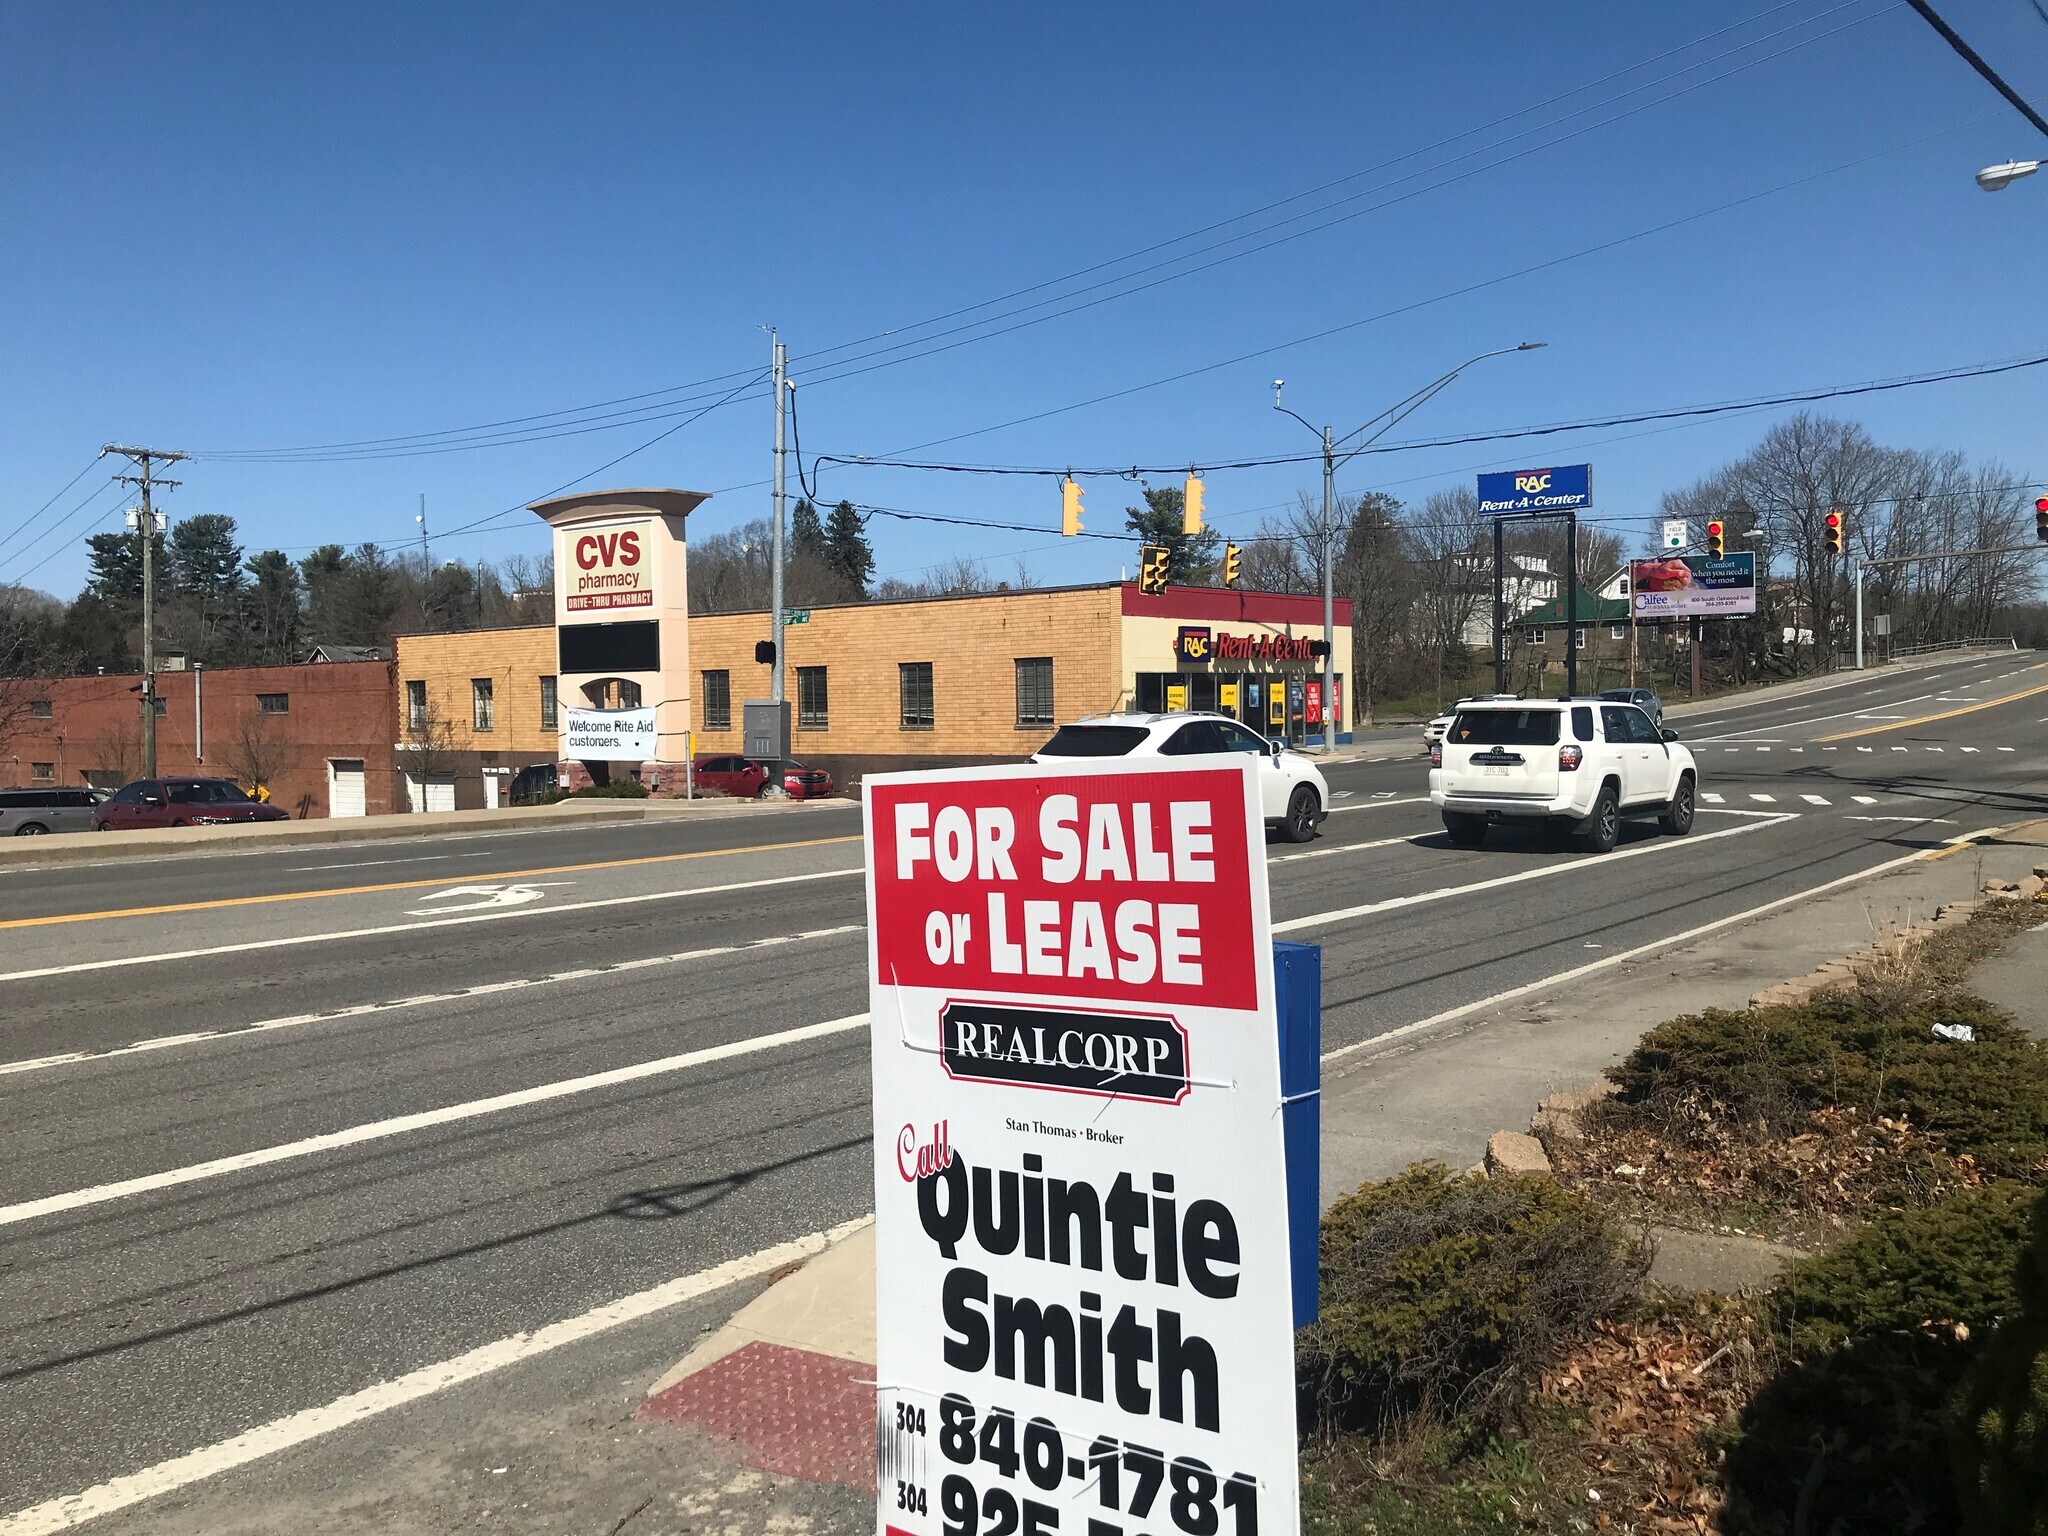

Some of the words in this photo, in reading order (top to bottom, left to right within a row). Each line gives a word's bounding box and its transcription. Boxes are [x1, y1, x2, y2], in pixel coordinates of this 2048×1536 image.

[1515, 475, 1551, 493] RAC
[575, 530, 641, 571] CVS
[578, 571, 640, 593] pharmacy
[1692, 569, 1711, 577] when
[1712, 570, 1726, 578] you
[1726, 568, 1743, 576] need
[567, 594, 611, 610] DRIVE-THRU
[612, 591, 652, 607] PHARMACY
[1635, 593, 1668, 610] Calfee
[1184, 636, 1208, 658] RAC
[568, 720, 612, 733] Welcome
[614, 719, 634, 733] Rite
[636, 719, 653, 732] Aid
[569, 735, 622, 748] customers.
[924, 910, 972, 966] or
[954, 1020, 1171, 1078] REALCORP
[1005, 1117, 1030, 1133] Stan
[1032, 1119, 1078, 1139] Thomas
[1085, 1127, 1125, 1146] Broker
[896, 1119, 954, 1184] Call
[916, 1149, 1241, 1299] Quintie
[942, 1266, 1221, 1434] Smith
[895, 1401, 926, 1438] 304
[938, 1391, 1260, 1536] 840-1781
[896, 1480, 928, 1517] 304
